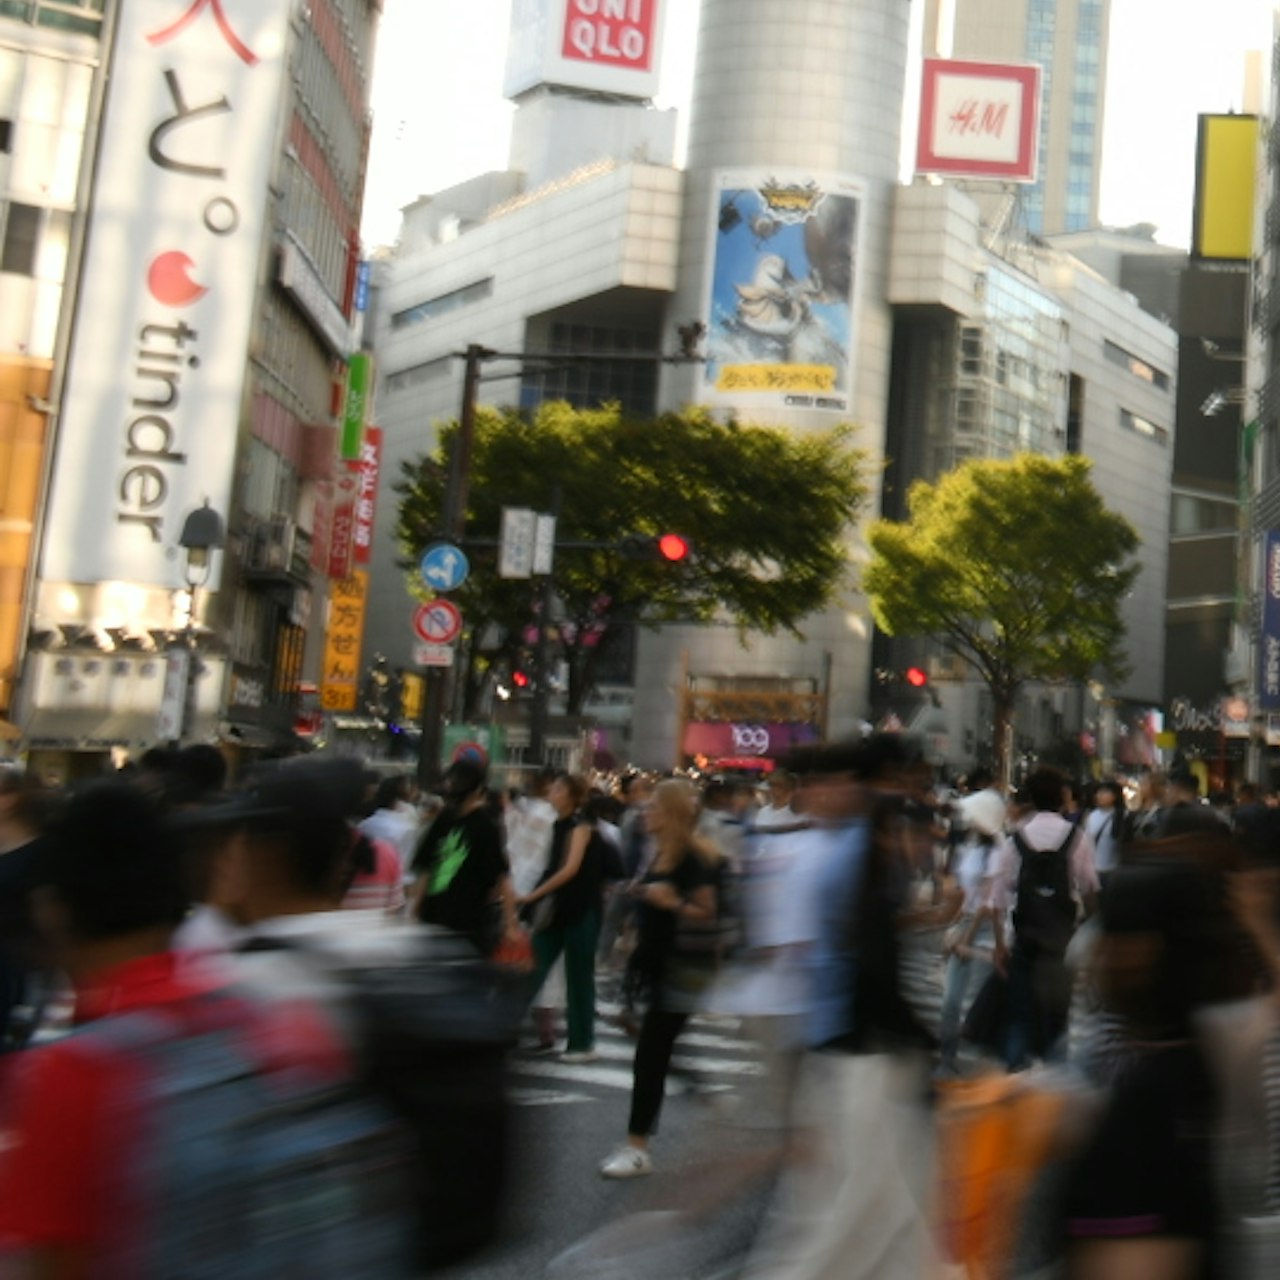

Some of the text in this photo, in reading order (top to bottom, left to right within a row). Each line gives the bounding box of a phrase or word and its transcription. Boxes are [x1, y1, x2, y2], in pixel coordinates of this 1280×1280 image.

[568, 16, 646, 61] QLO
[948, 97, 1010, 140] H&M
[117, 319, 199, 546] tinder
[729, 722, 771, 756] 109
